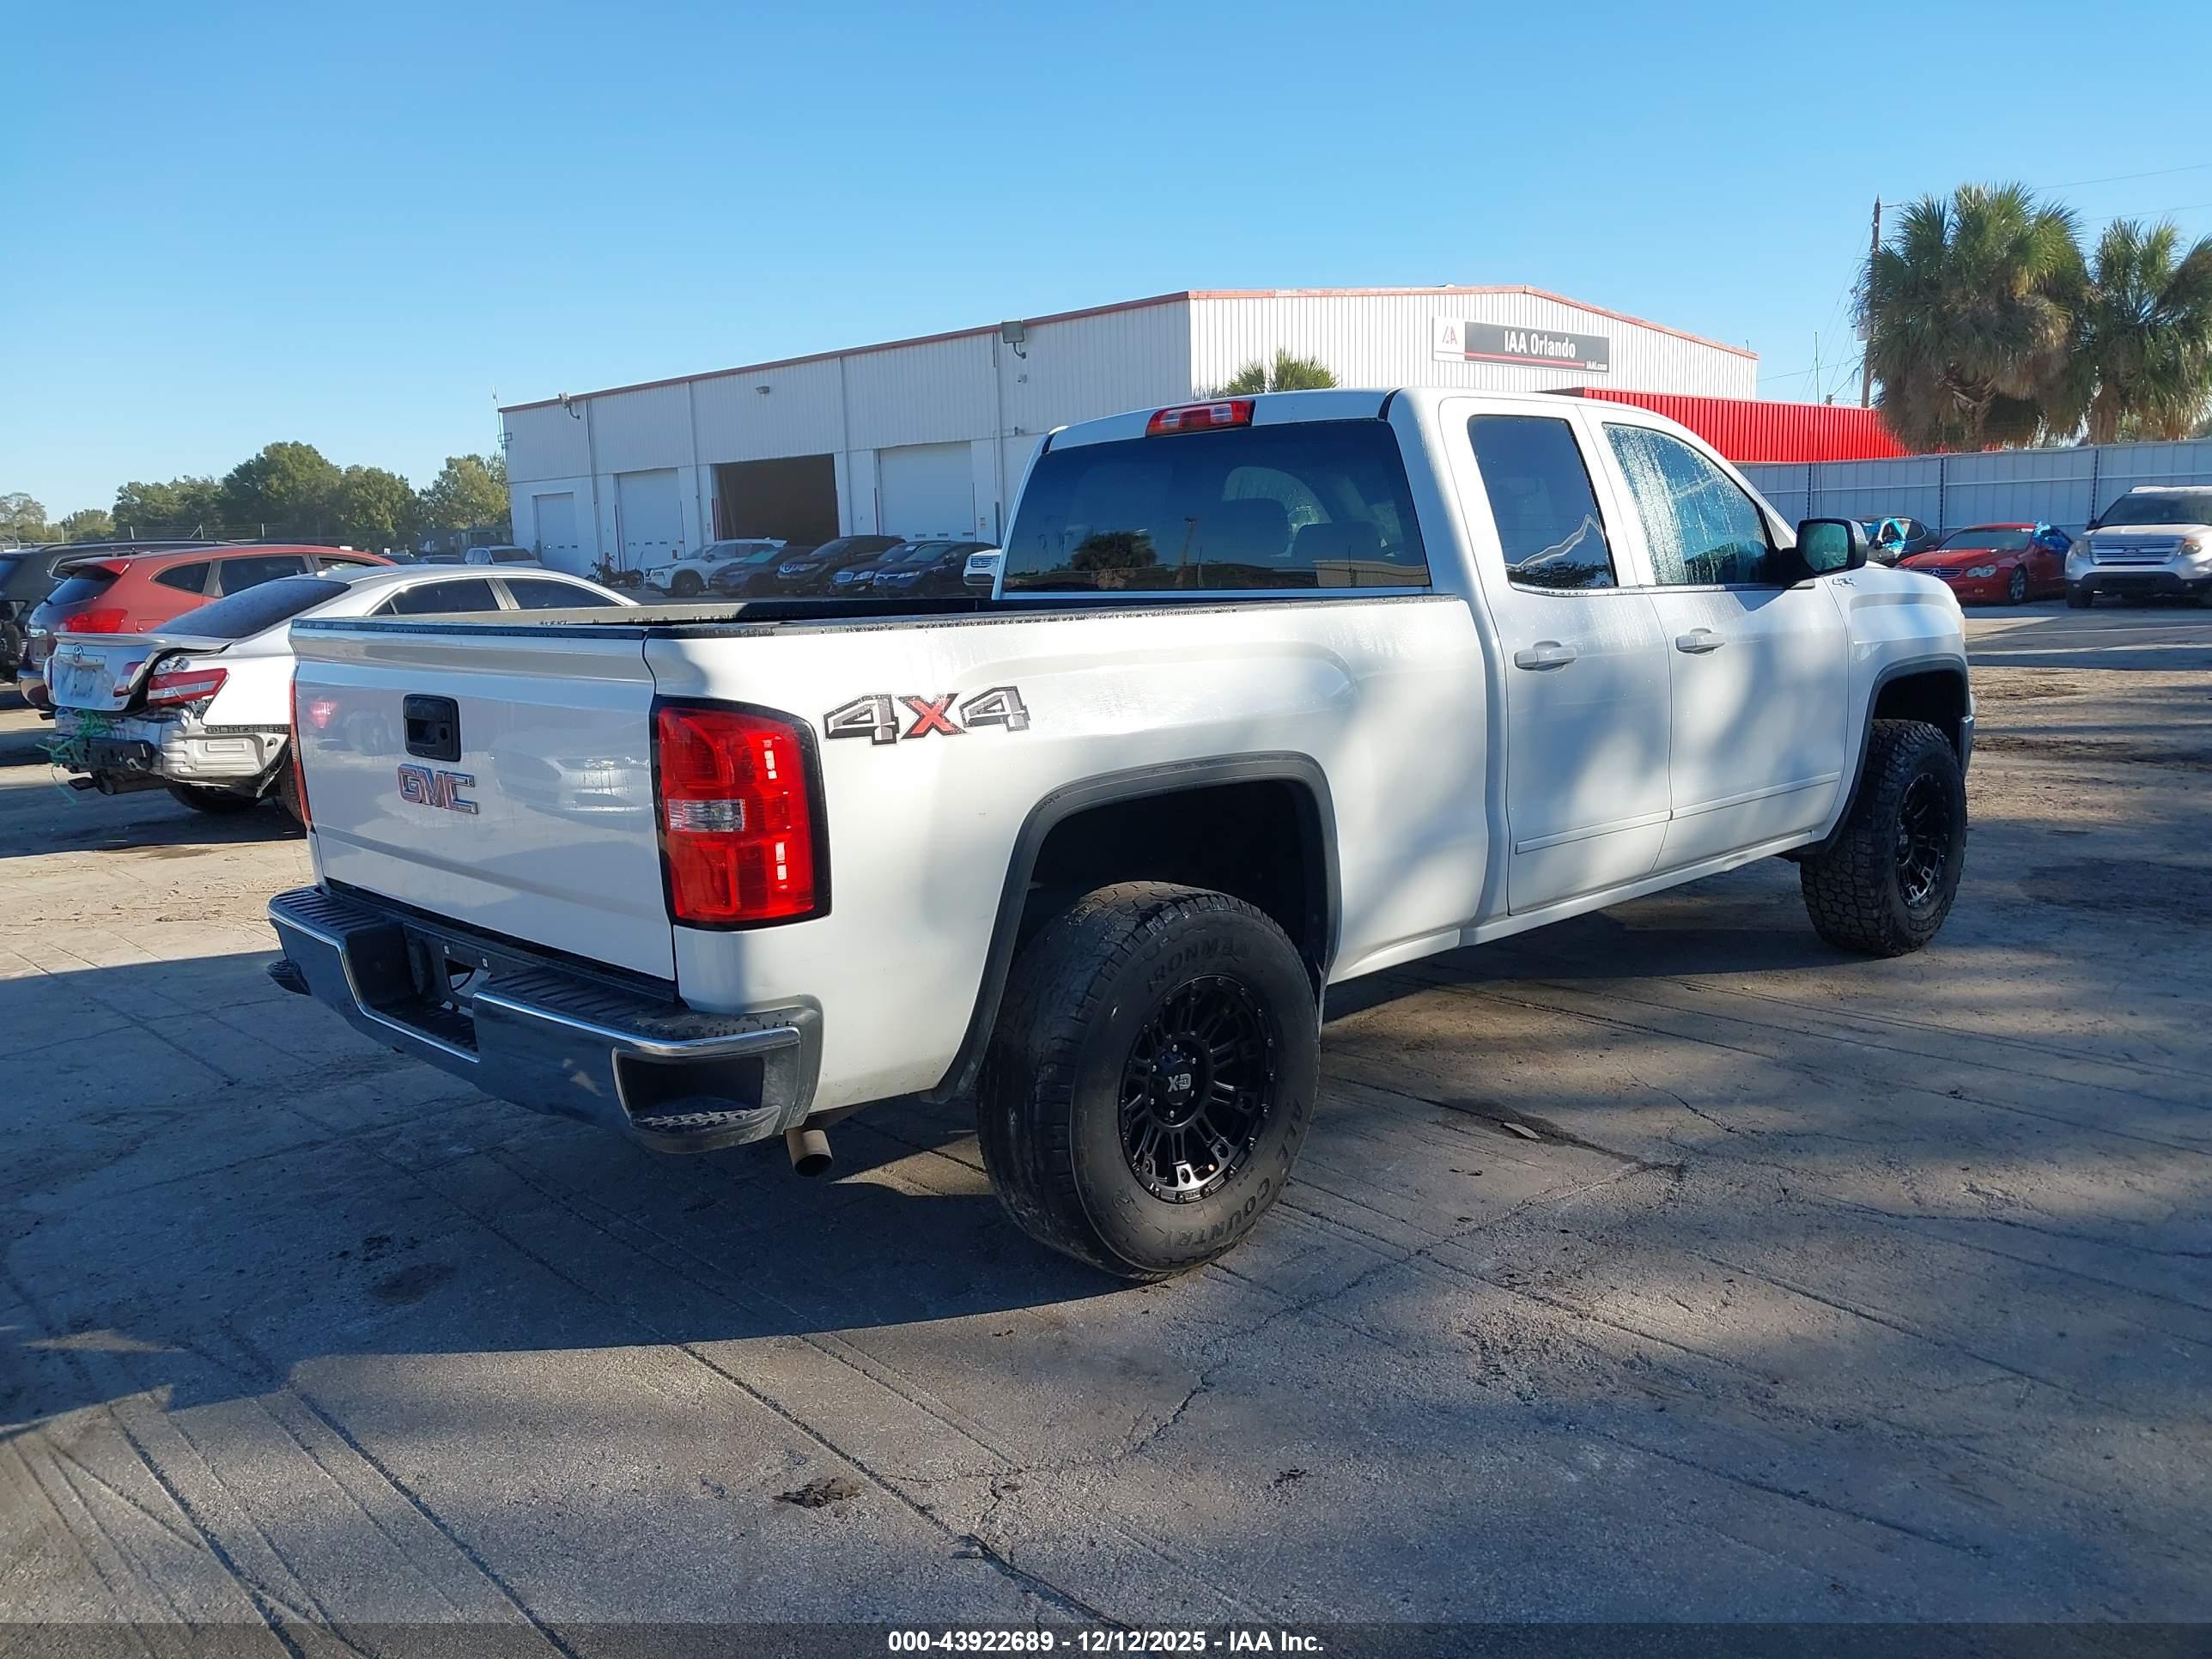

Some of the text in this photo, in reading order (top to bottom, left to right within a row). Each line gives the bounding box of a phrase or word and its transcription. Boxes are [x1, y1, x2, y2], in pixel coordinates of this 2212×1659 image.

[1504, 330, 1577, 358] IAA Orlando
[823, 685, 1031, 746] 4X4
[397, 763, 479, 815] GMC
